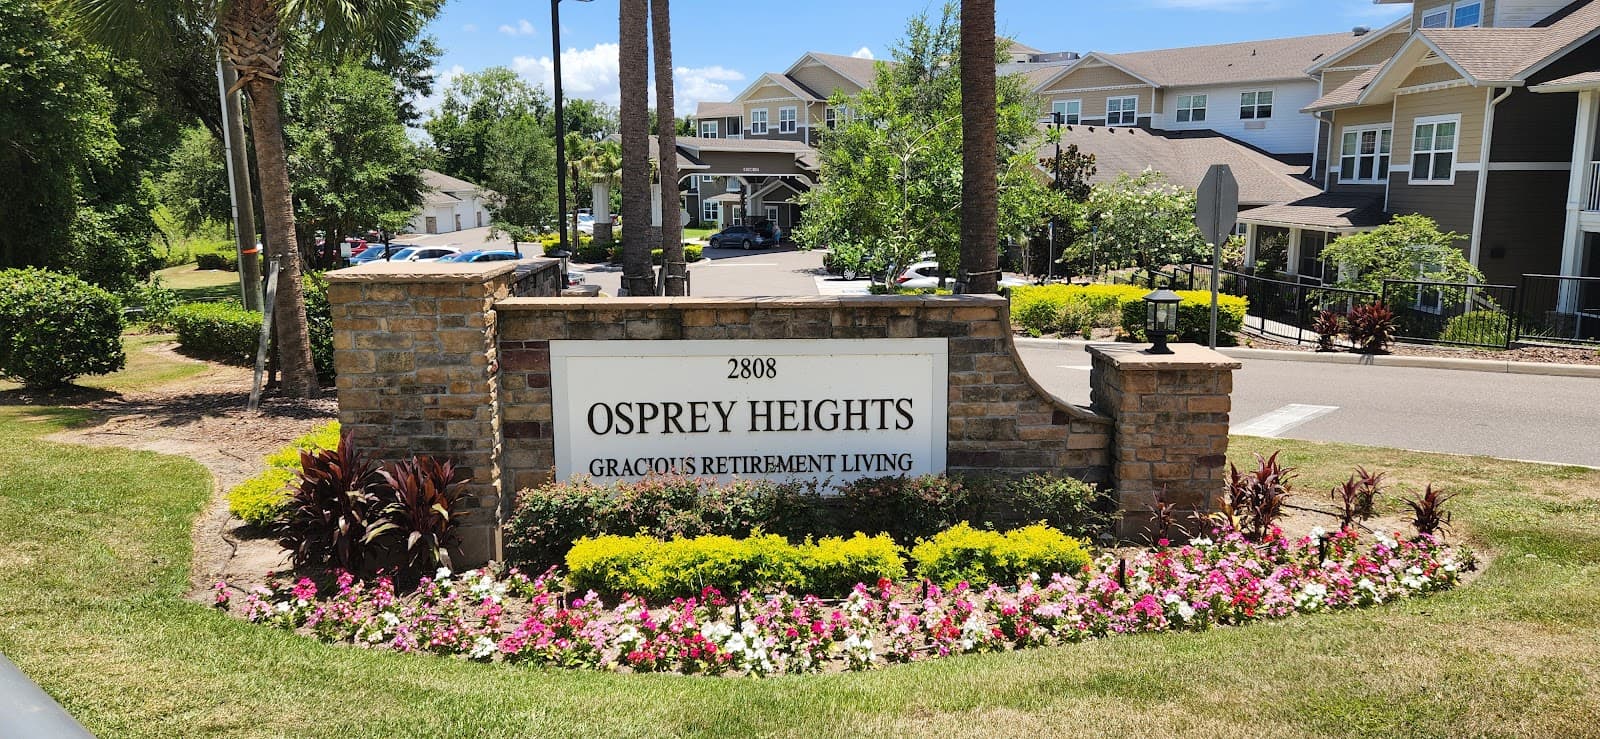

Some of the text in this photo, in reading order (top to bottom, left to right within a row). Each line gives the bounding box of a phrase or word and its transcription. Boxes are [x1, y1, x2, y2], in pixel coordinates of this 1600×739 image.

[727, 357, 777, 379] 2808
[587, 397, 914, 436] OSPREY HEIGHTS
[589, 453, 914, 477] GRACIOUS RETIREMENT LIVING
